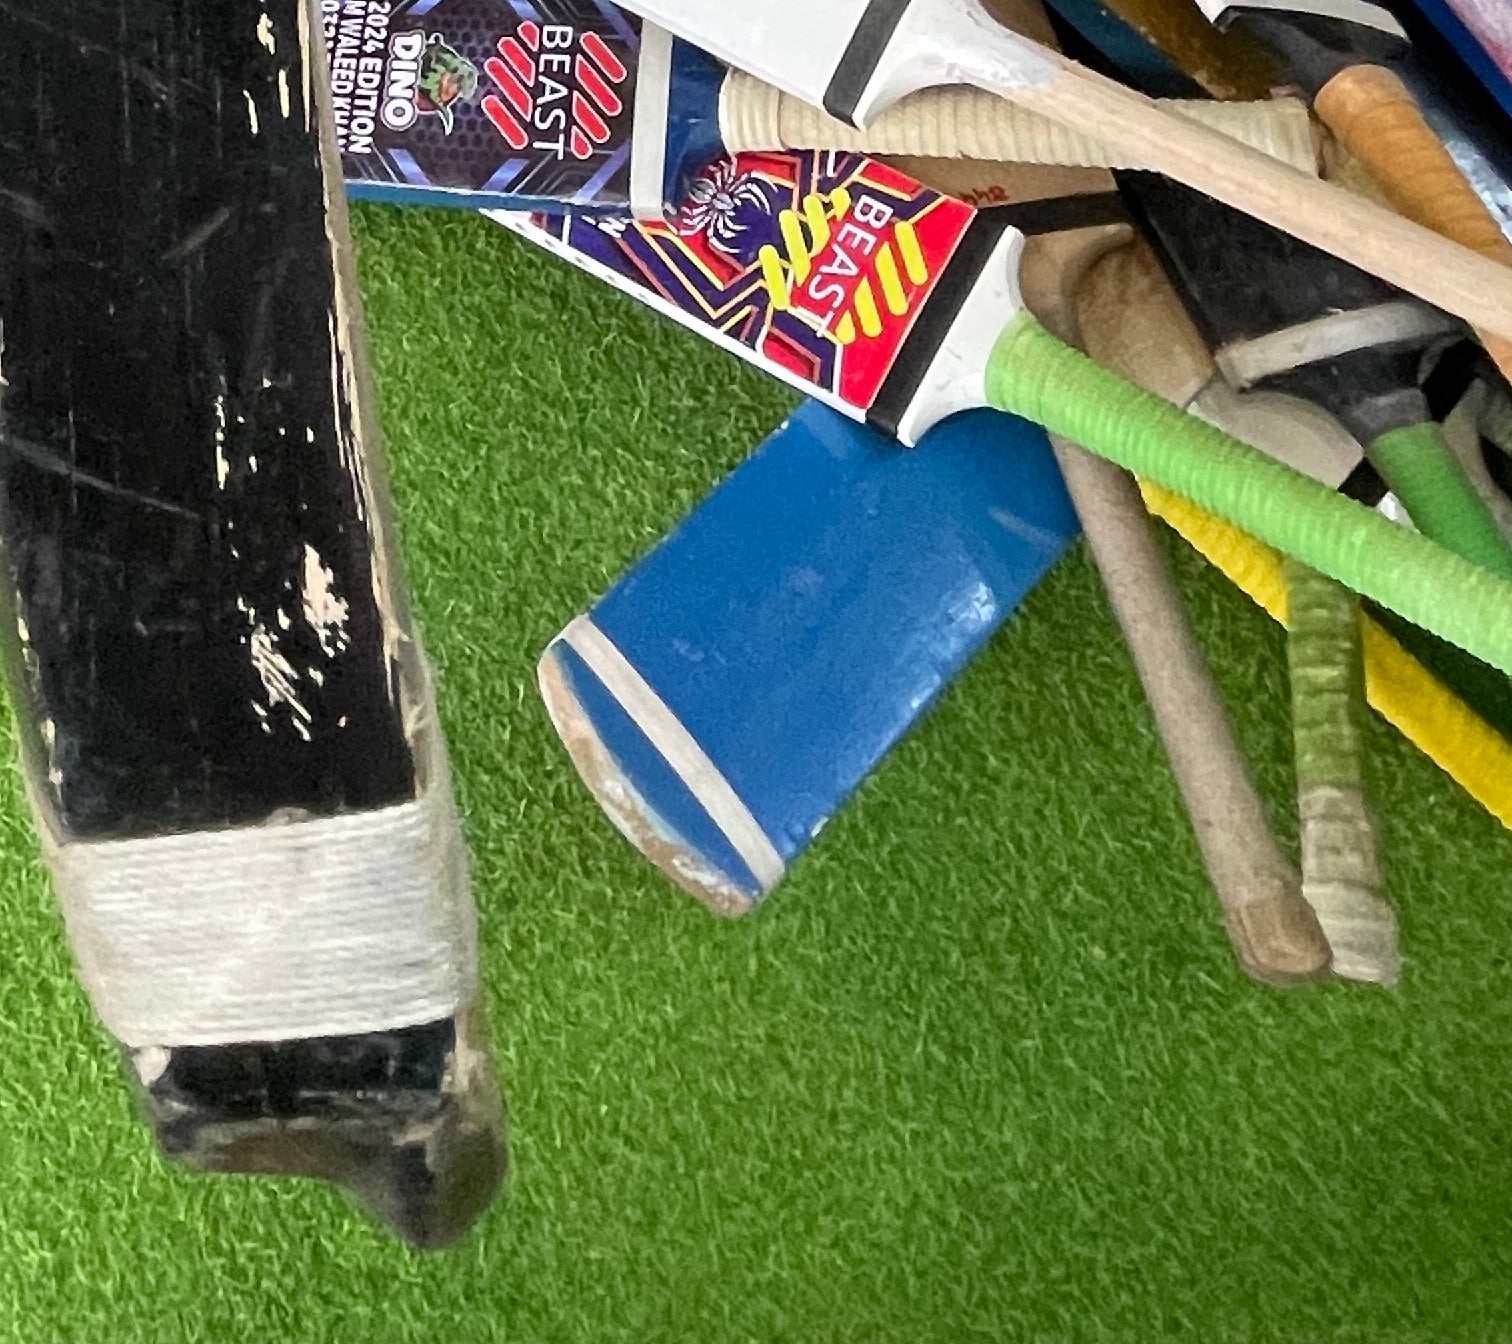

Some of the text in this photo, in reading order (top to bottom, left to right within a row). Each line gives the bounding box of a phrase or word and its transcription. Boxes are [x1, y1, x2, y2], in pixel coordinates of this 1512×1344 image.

[331, 17, 365, 95] WALEED
[348, 0, 392, 155] 2024 EDITION
[381, 30, 424, 130] DINO
[533, 23, 575, 161] BEAST
[789, 192, 889, 338] BEAST
